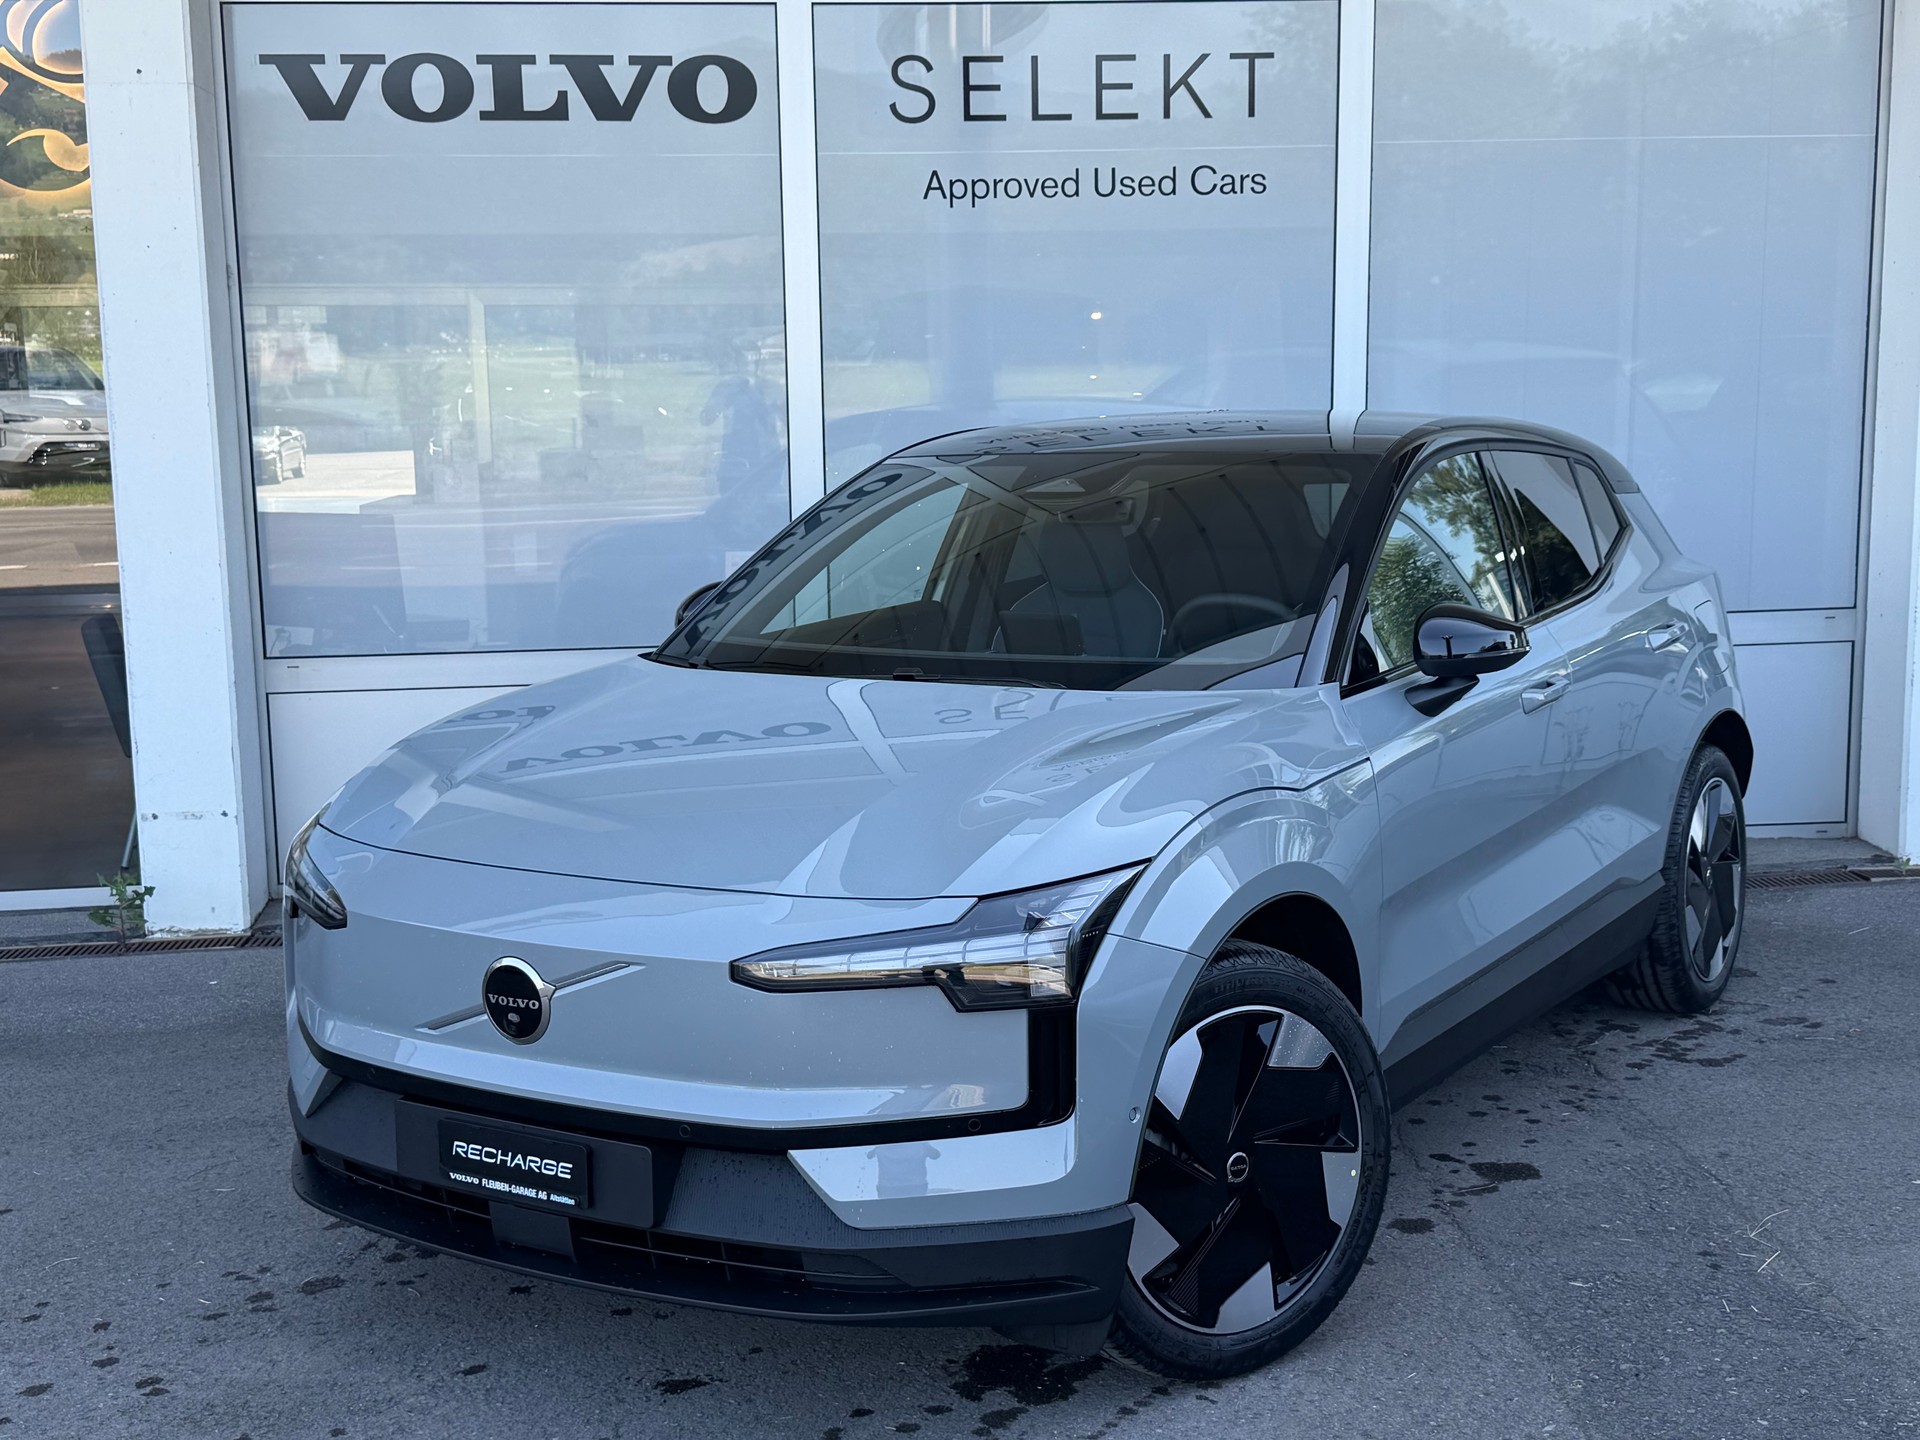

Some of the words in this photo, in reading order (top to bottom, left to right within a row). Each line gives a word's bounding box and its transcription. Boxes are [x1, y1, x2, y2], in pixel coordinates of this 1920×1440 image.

[258, 52, 758, 124] VOLVO
[889, 52, 1275, 125] SELEKT
[922, 168, 1080, 209] Approved
[1094, 166, 1177, 198] Used
[1190, 164, 1268, 196] Cars
[487, 993, 540, 1010] VOLVO
[452, 1140, 573, 1180] RECHARGE
[448, 1171, 480, 1185] VOLVO
[537, 1189, 549, 1201] AG
